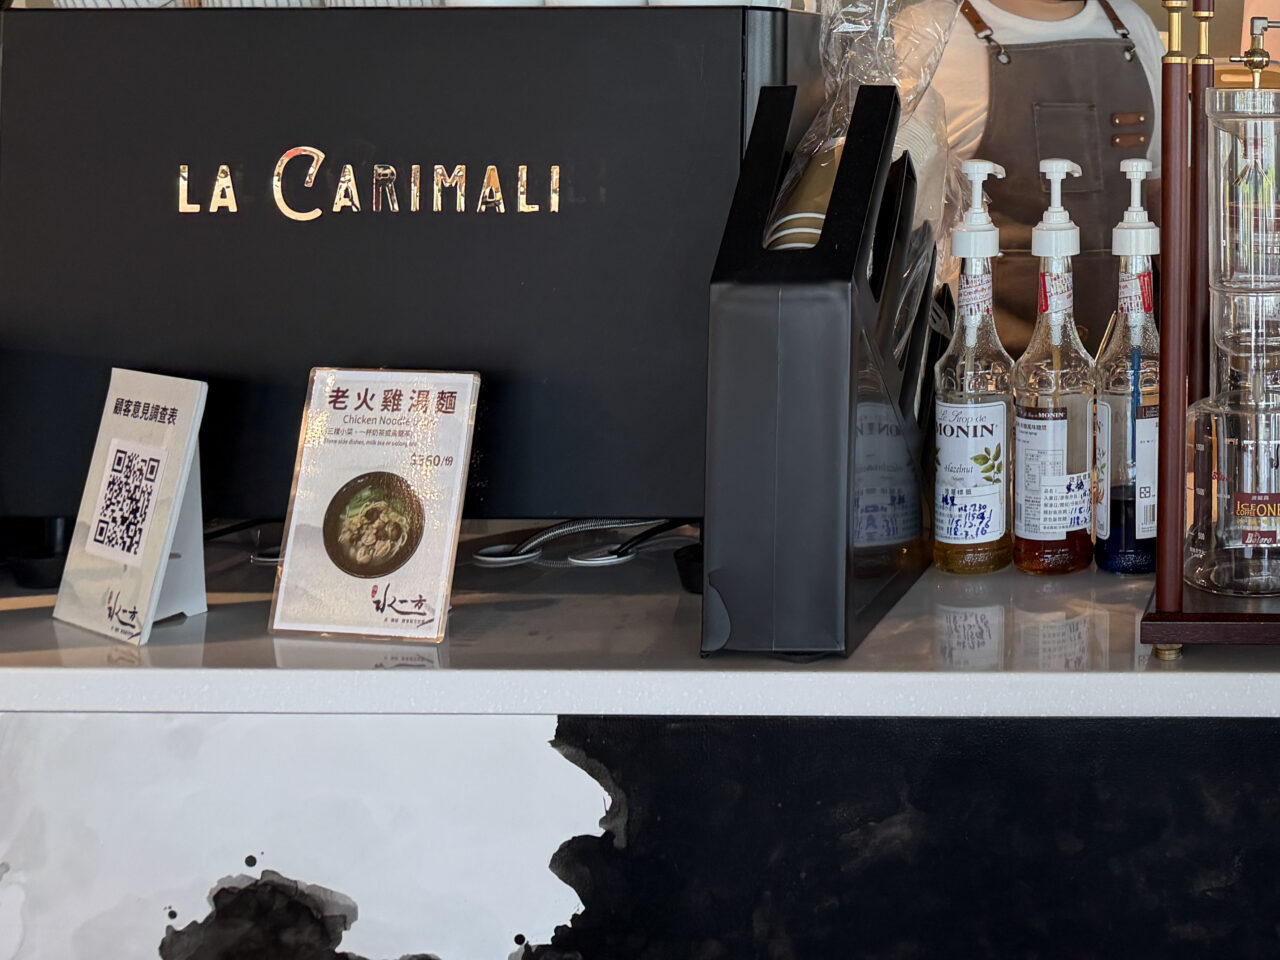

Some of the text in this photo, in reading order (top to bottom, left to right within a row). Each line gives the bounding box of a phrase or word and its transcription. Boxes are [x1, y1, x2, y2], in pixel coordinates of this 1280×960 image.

[178, 146, 560, 221] LA CARIMALI
[113, 397, 179, 426] 顧客意見調查表
[328, 386, 457, 415] 老火雞湯麵
[1039, 410, 1064, 418] MONIN
[343, 414, 377, 425] Chicken
[379, 416, 410, 426] Noodle
